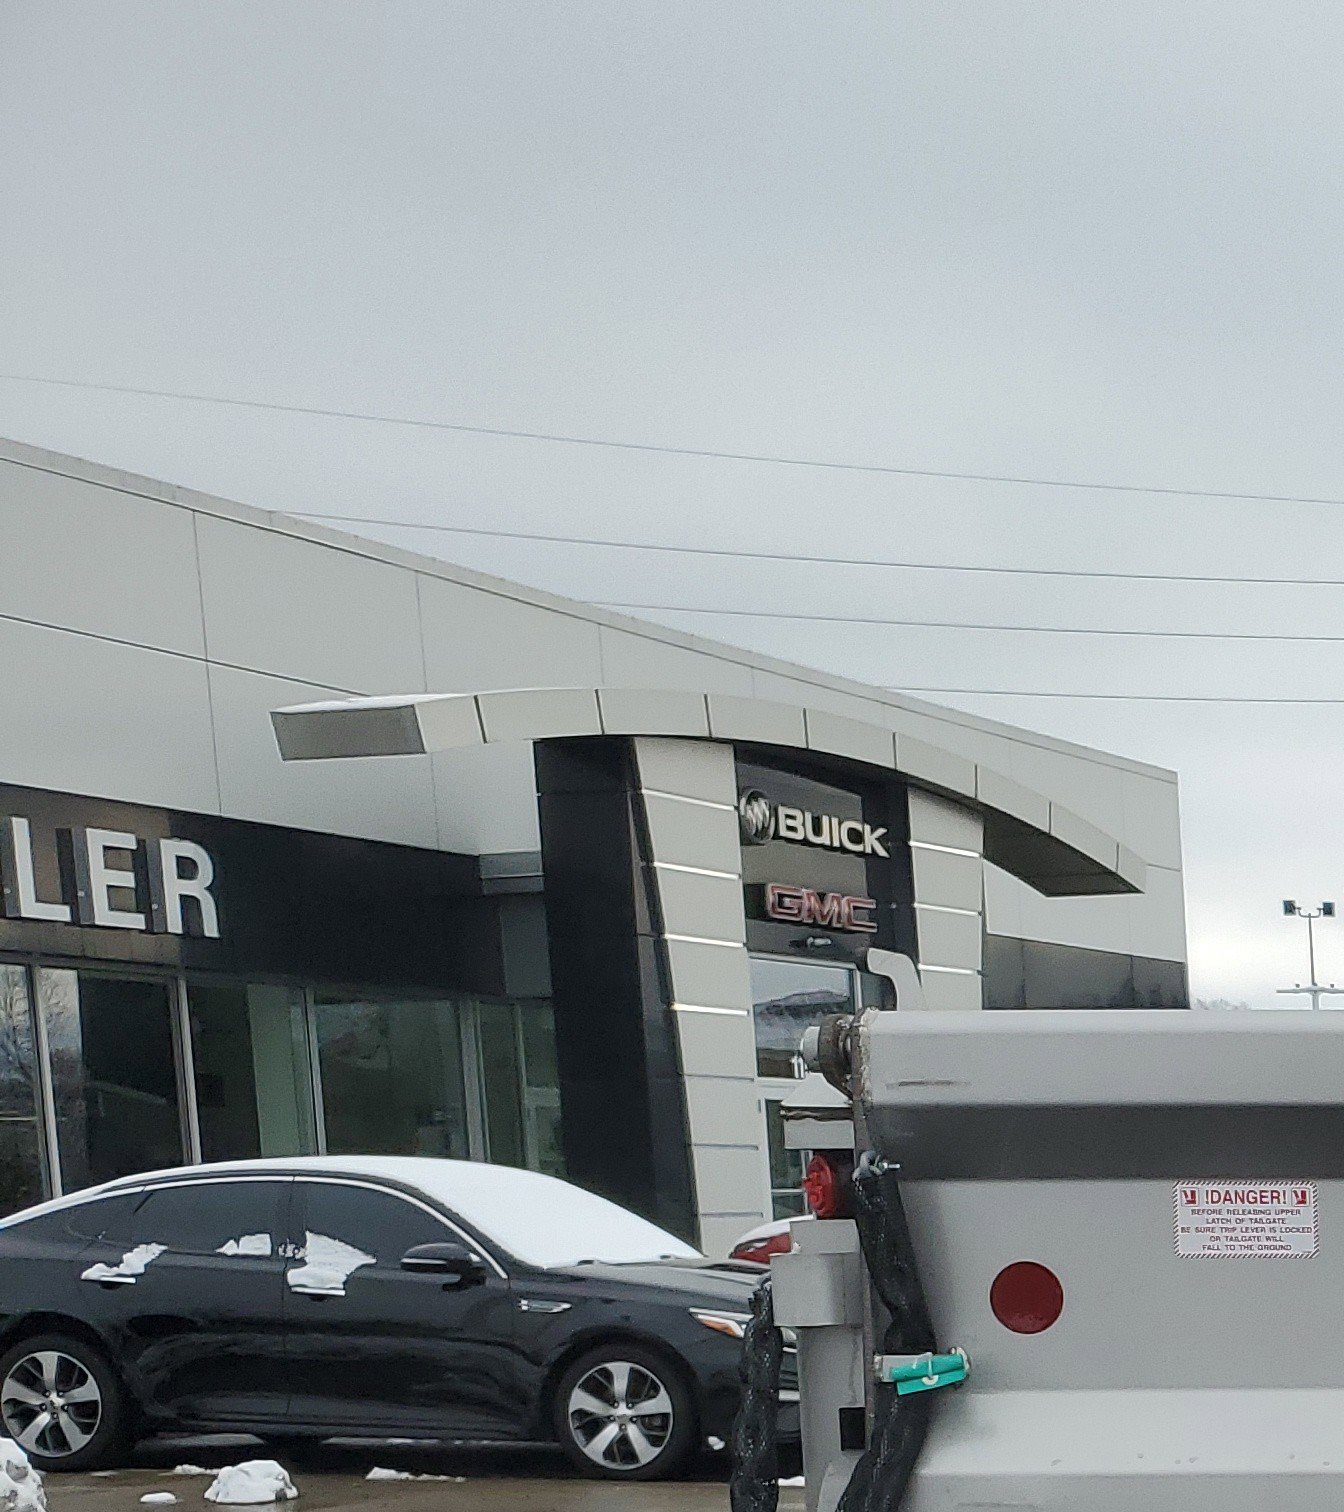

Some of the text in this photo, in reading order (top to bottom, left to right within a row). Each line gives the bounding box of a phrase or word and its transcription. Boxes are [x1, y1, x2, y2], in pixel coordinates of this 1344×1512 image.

[777, 804, 891, 858] BUICK
[10, 815, 220, 938] LER
[766, 882, 878, 933] GMC
[1190, 1208, 1301, 1216] BEFORE RELEASING UPPER
[1206, 1217, 1287, 1225] LATCH OF TAILGATE
[1180, 1226, 1191, 1234] BE
[1195, 1226, 1216, 1234] SURE
[1240, 1226, 1266, 1234] LEVER
[1269, 1226, 1277, 1234] IS
[1279, 1226, 1313, 1234] LOCKED
[1209, 1235, 1221, 1243] OR
[1224, 1235, 1262, 1243] TAILGATE
